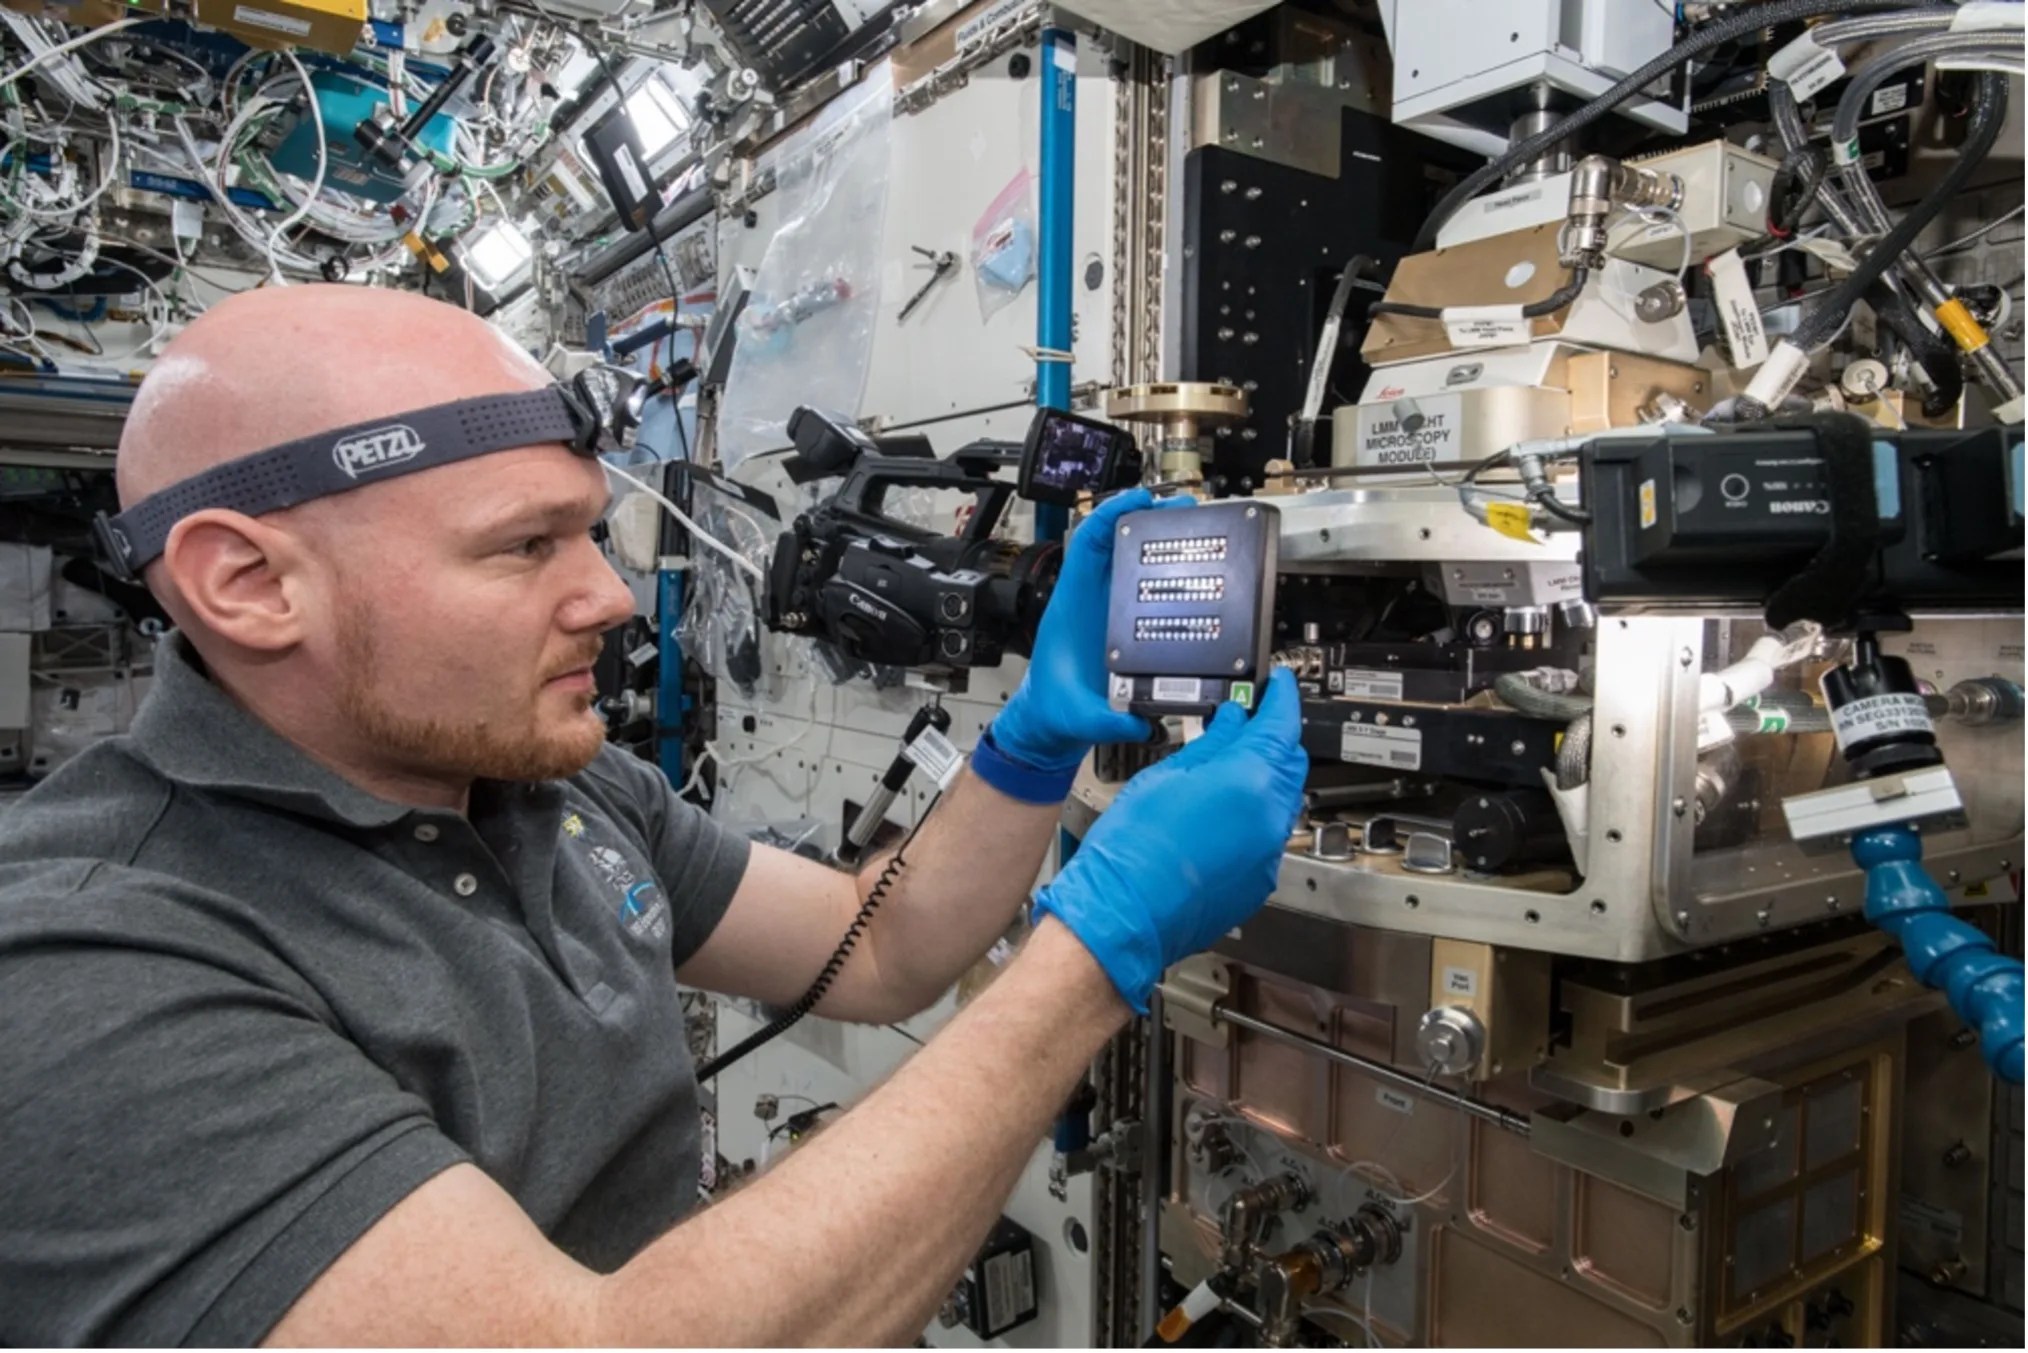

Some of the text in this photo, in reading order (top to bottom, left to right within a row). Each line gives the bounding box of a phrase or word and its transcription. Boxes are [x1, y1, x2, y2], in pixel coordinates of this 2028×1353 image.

[338, 429, 426, 479] PETZL
[1769, 500, 1830, 514] Canon
[849, 592, 888, 620] Canon
